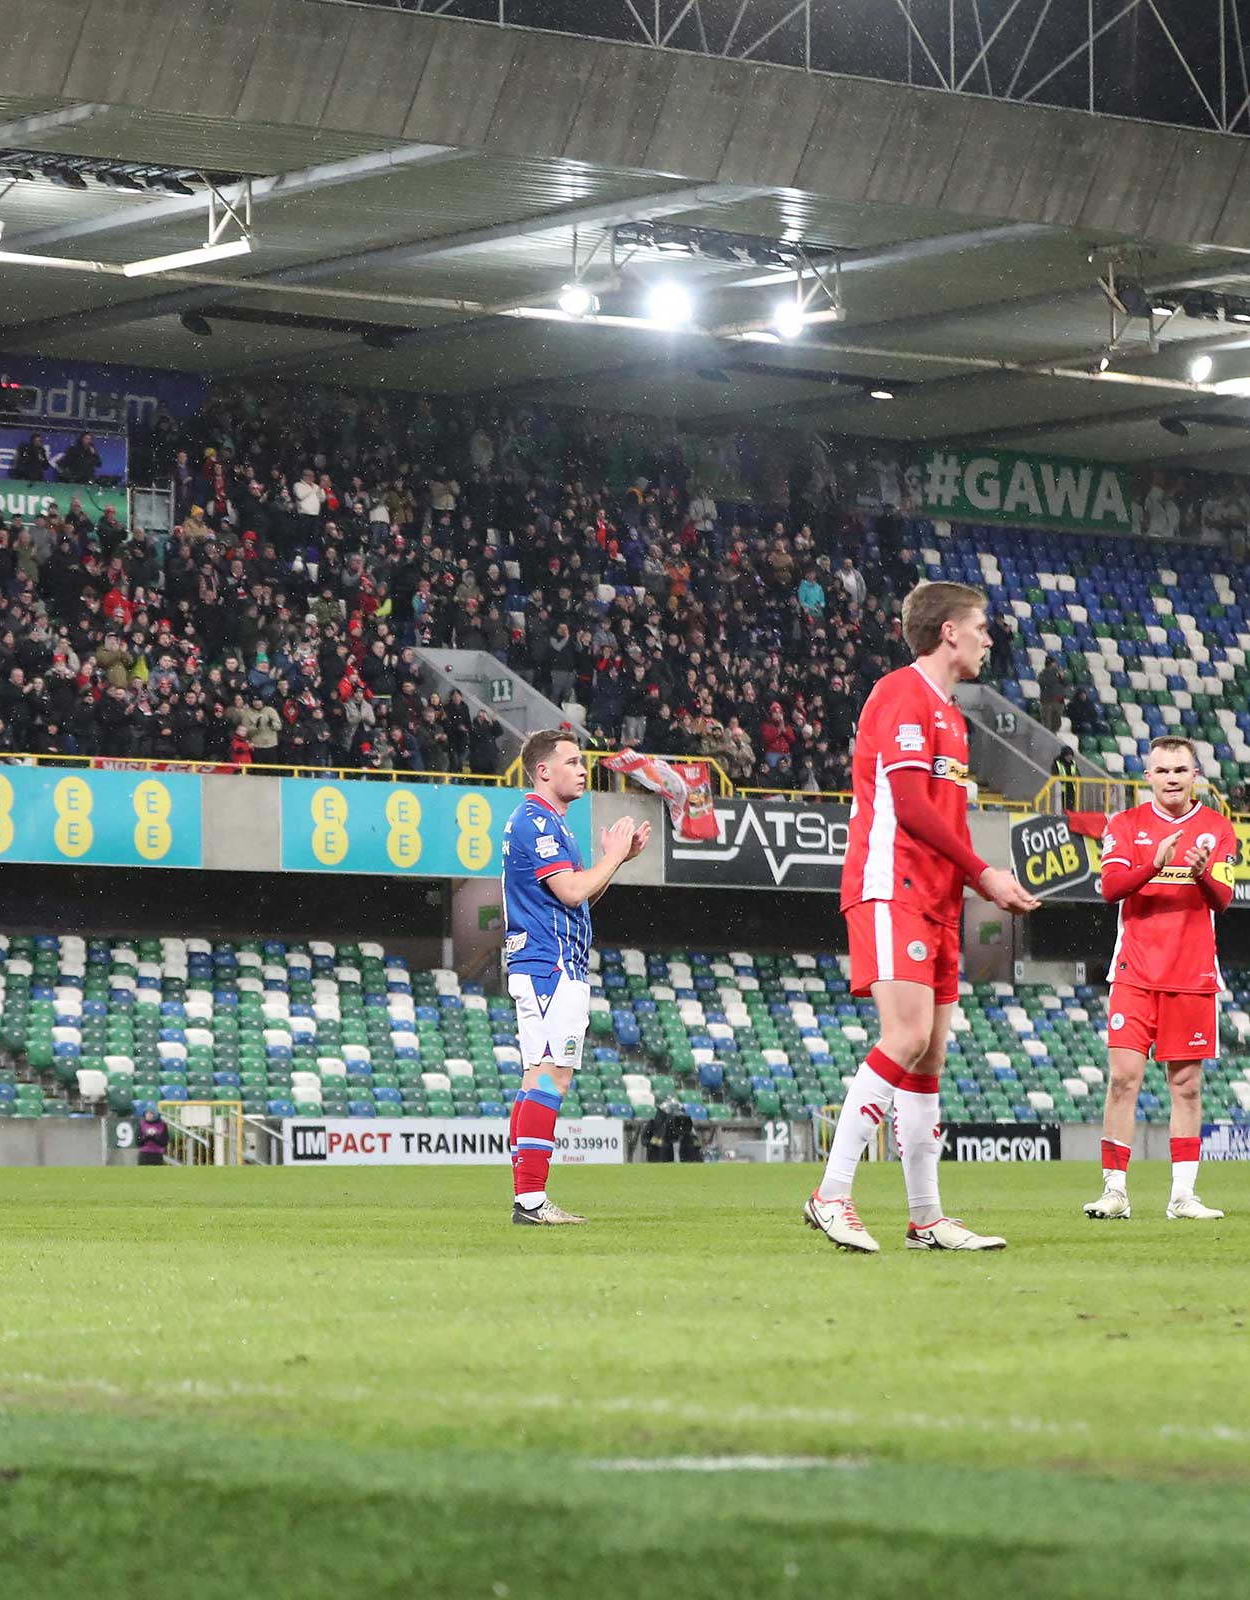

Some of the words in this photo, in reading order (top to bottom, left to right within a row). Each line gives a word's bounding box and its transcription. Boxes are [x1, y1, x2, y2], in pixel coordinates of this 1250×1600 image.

[923, 451, 1131, 524] #GAWA
[492, 679, 511, 702] 11
[995, 712, 1016, 733] 13
[1021, 821, 1070, 857] fona
[1025, 844, 1080, 886] CAB
[116, 1121, 134, 1148] 9
[296, 1131, 392, 1157] IMPACT
[400, 1132, 512, 1155] TRAININ
[574, 1138, 618, 1150] 339910
[763, 1121, 789, 1146] 12
[956, 1136, 1051, 1162] macron
